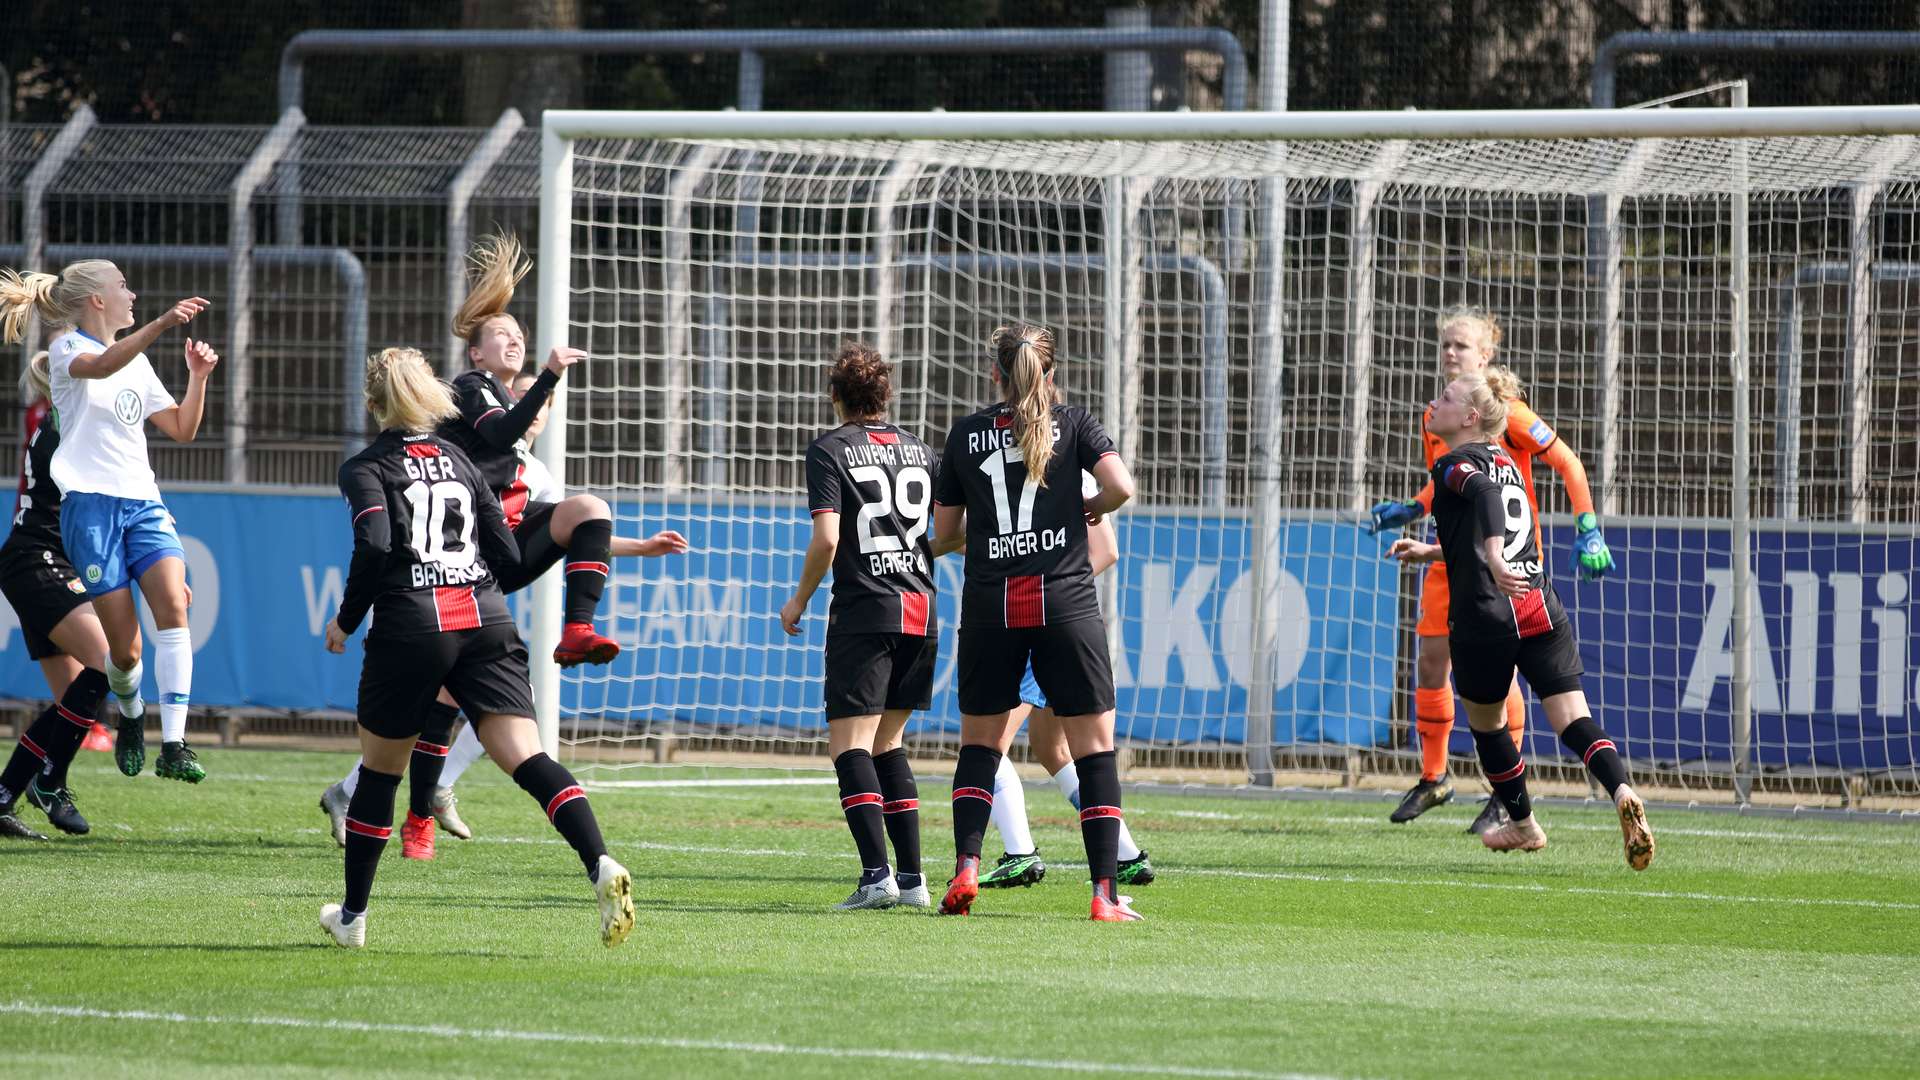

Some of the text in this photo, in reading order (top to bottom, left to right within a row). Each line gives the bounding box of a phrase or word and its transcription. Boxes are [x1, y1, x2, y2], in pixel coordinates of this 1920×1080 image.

[403, 456, 456, 480] GIER
[899, 445, 928, 466] LEITE
[968, 421, 1060, 454] RINGG
[403, 480, 478, 568] 10
[848, 465, 931, 554] 29
[979, 447, 1040, 535] 17
[1500, 484, 1531, 562] 9
[988, 527, 1066, 559] BAYER 04
[609, 574, 742, 645] EAM
[1112, 562, 1310, 692] KO
[1681, 567, 1920, 718] Alli
